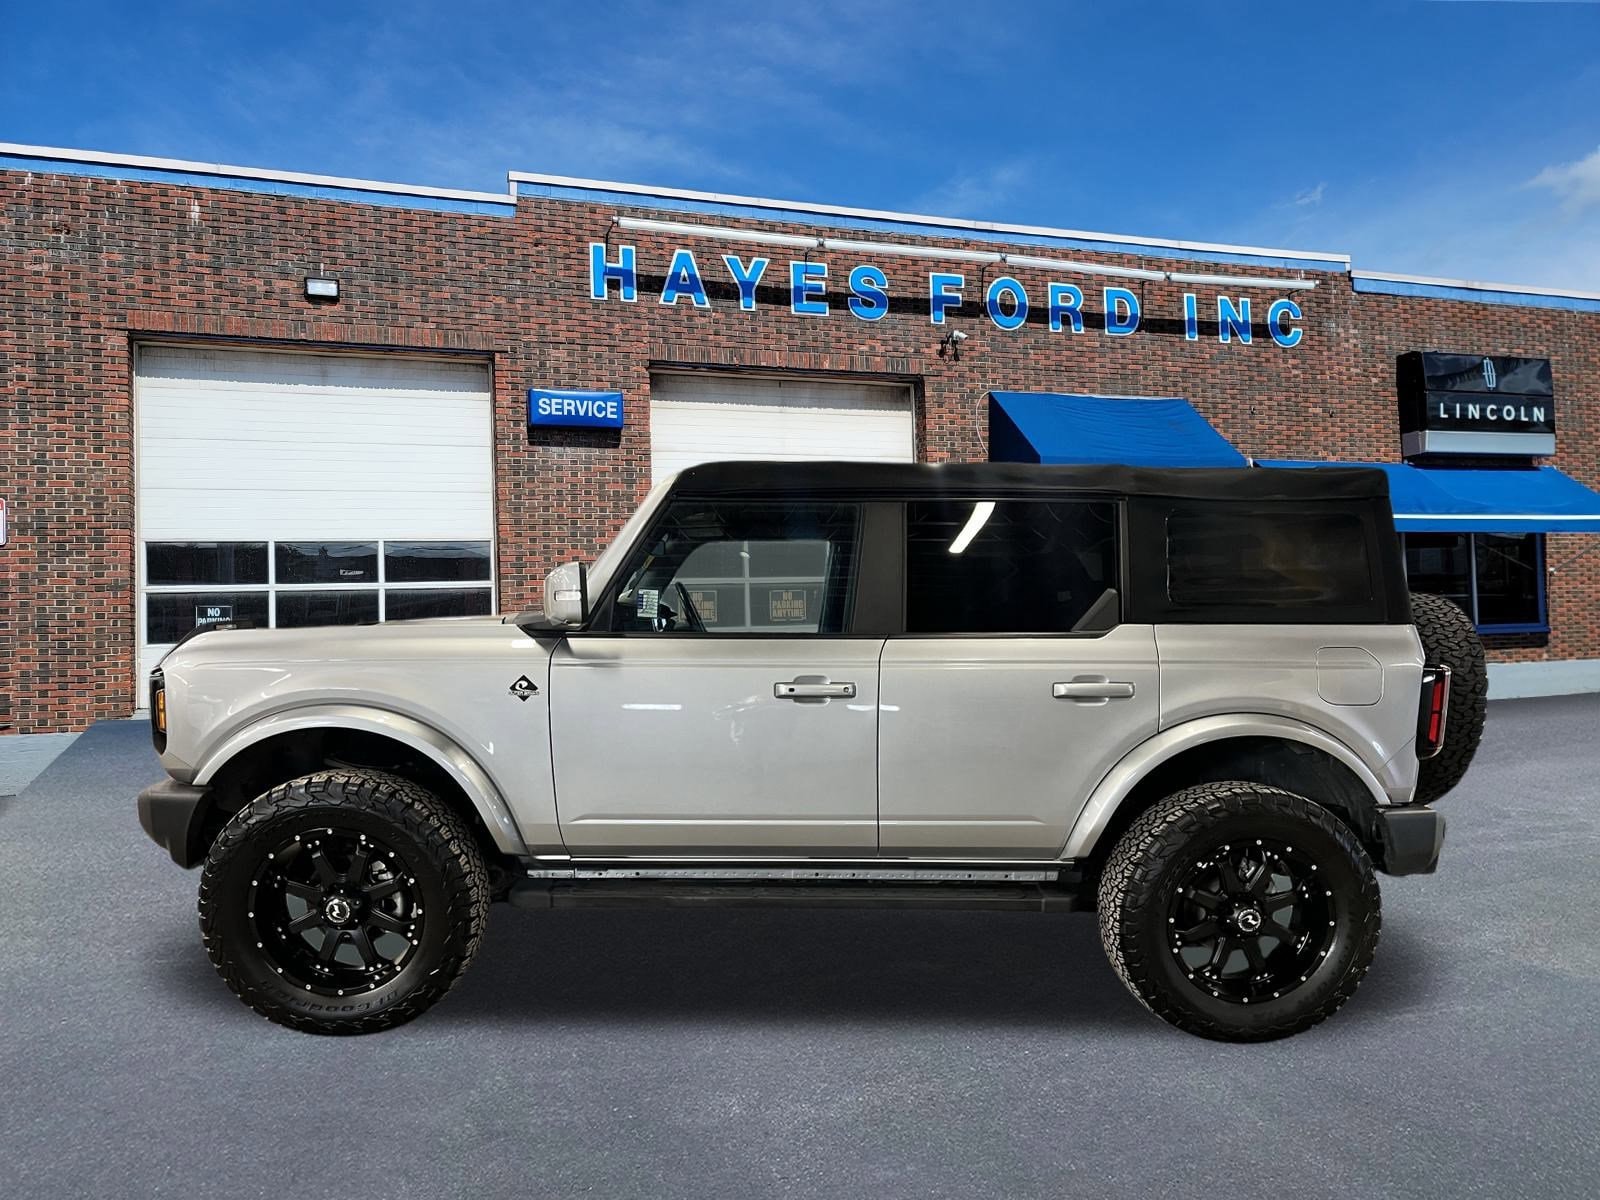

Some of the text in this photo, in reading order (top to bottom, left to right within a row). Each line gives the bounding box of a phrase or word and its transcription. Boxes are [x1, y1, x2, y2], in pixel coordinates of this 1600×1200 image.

[589, 242, 1304, 348] HAYES FORD INC
[538, 397, 618, 419] SERVICE
[1439, 402, 1545, 423] LINCOLN
[782, 591, 792, 600] NO
[772, 599, 803, 609] PARKING
[207, 607, 220, 617] NO
